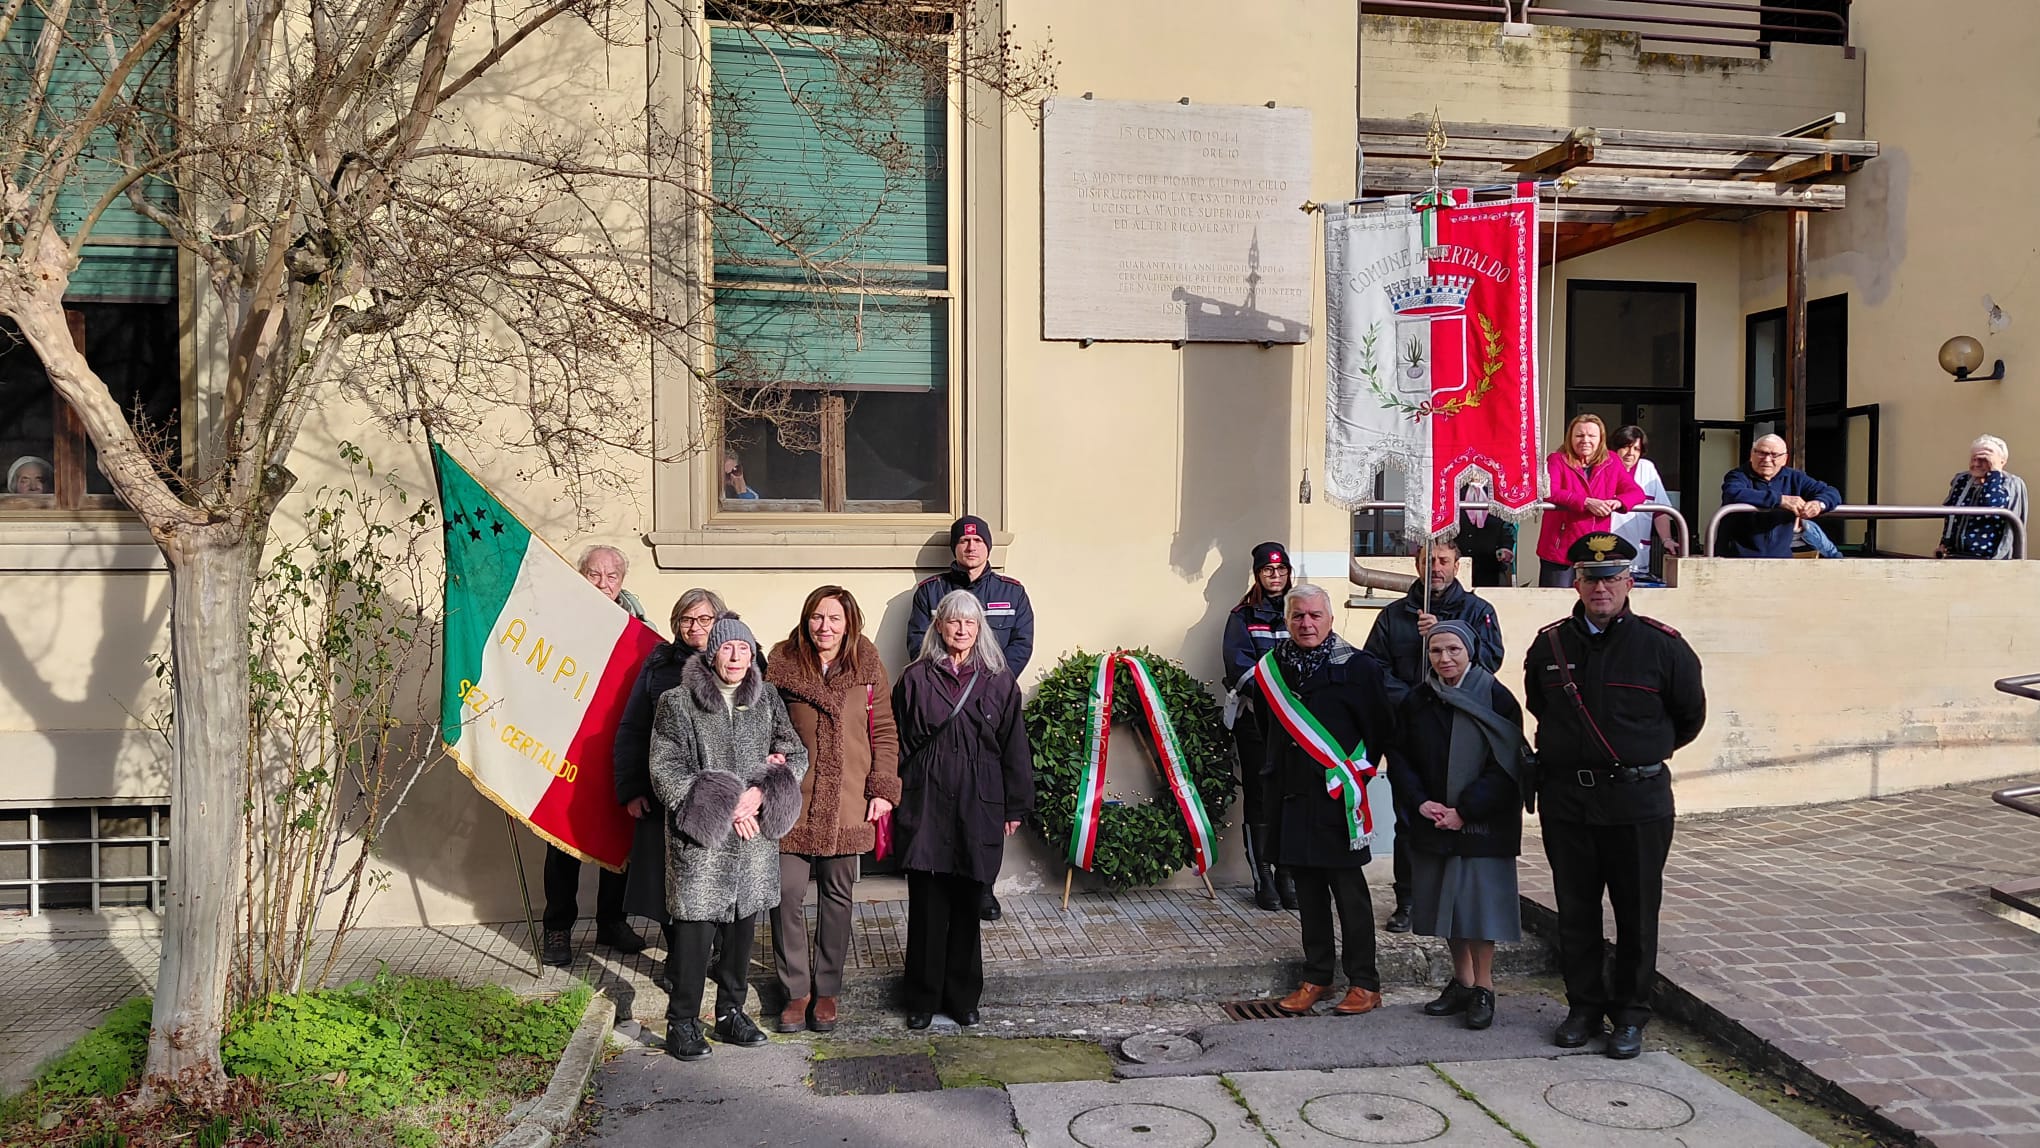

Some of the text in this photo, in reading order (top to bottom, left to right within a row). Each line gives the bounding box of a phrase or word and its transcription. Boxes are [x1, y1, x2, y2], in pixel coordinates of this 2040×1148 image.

[1137, 126, 1202, 143] GENNAIO
[1206, 131, 1239, 144] 1944
[1202, 147, 1240, 159] ORE 10
[1072, 170, 1088, 184] LA
[1092, 171, 1133, 185] MORTE
[1136, 173, 1159, 185] CHE
[1233, 178, 1254, 190] DAL
[1258, 179, 1288, 192] CIELO
[1077, 187, 1279, 207] DISTRUGGENDO LA CASA DI RIPOSO
[1092, 202, 1263, 220] UCCISE LA MADRE SUPERIORA
[1114, 218, 1240, 234] ED ALTRI RICOVERATI
[1118, 271, 1175, 283] CERTALDESE
[1192, 262, 1216, 273] ANNI
[1217, 263, 1240, 274] DOPO
[1349, 248, 1411, 294] COMUNE
[500, 723, 578, 783] CERTALDO
[1085, 695, 1195, 799] COMUNE CERTALDO
